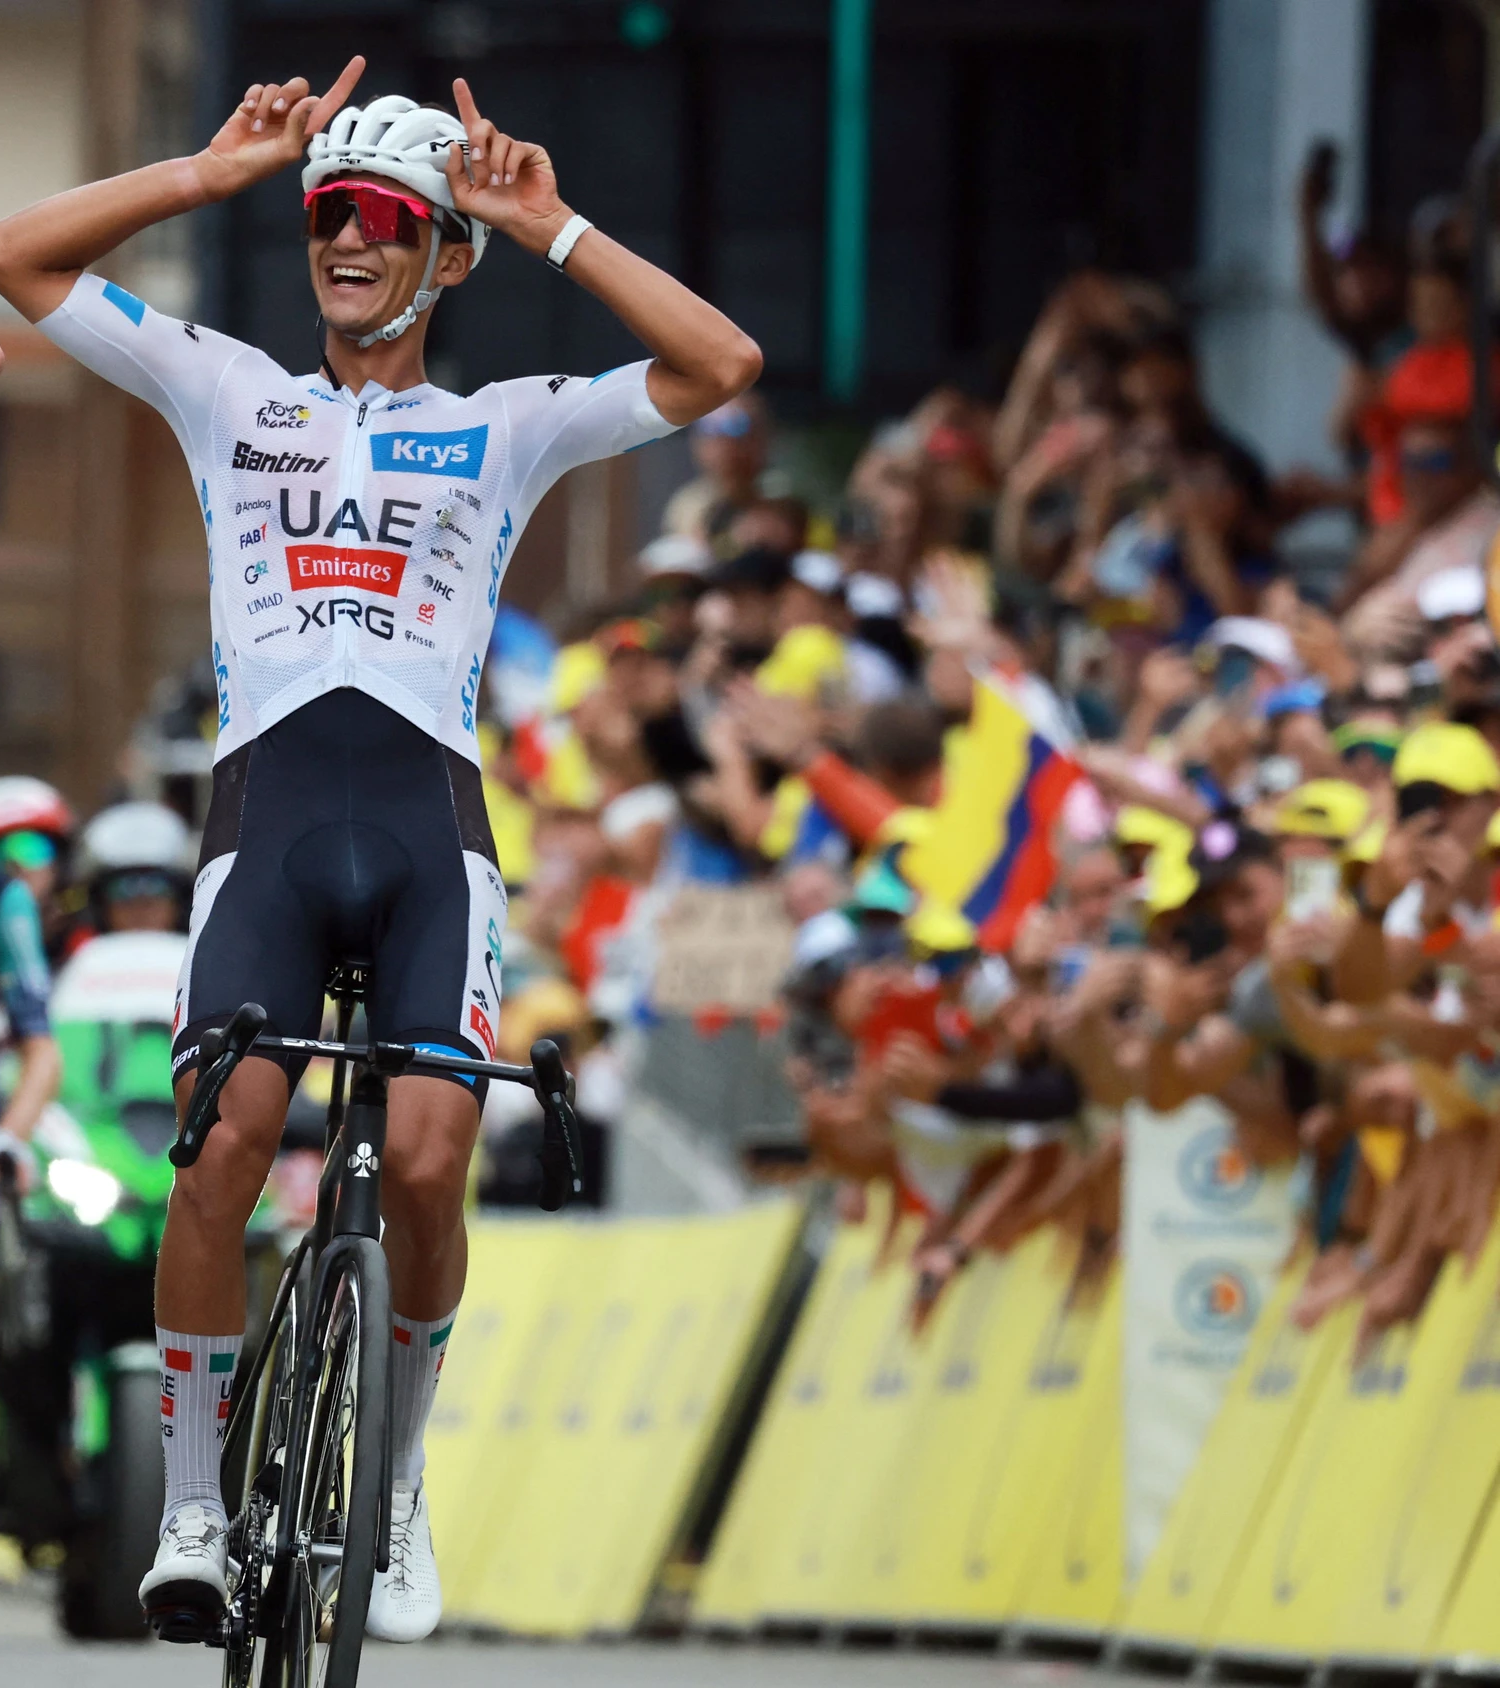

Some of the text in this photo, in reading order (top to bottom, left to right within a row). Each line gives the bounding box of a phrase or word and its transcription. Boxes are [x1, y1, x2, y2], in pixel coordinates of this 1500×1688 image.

[232, 440, 330, 473] Santini
[392, 438, 469, 468] Krys
[242, 499, 271, 513] Analog
[280, 487, 422, 548] UAE
[297, 556, 392, 583] Emirates
[432, 577, 456, 602] IHC
[295, 597, 395, 641] XRG
